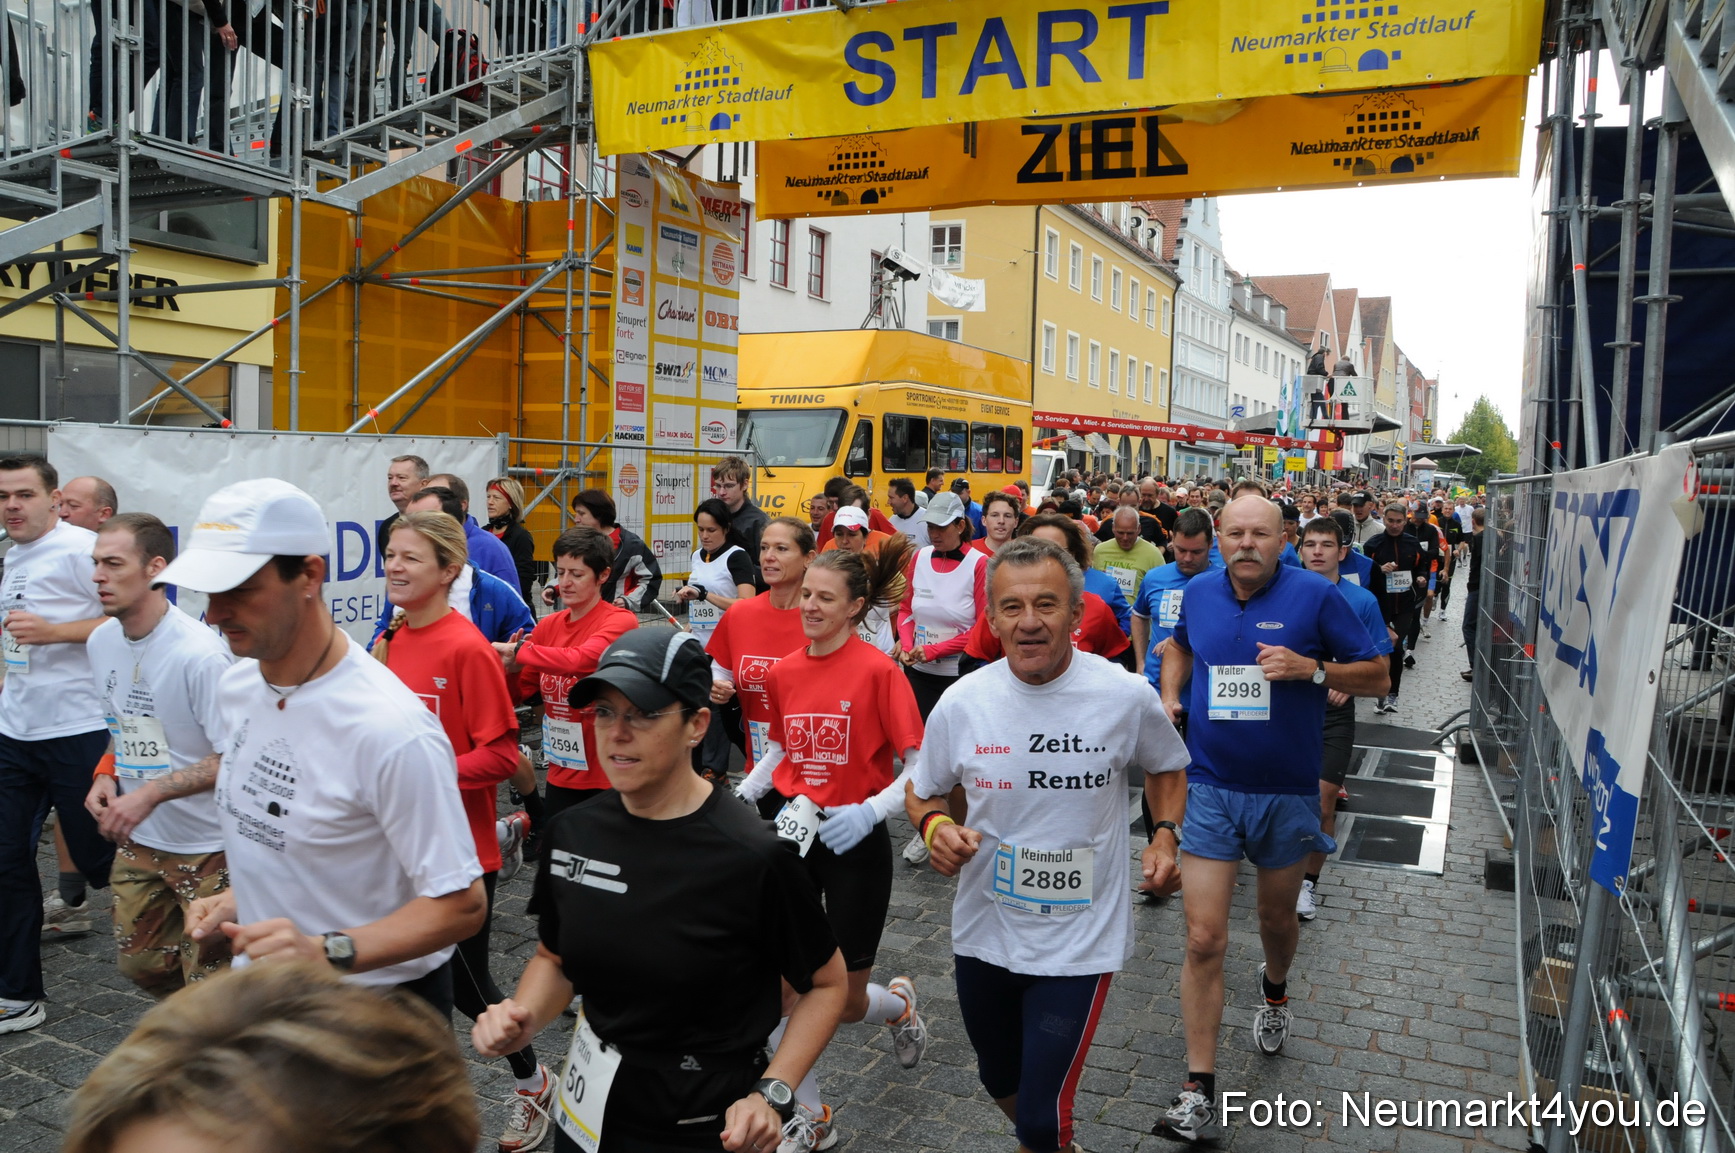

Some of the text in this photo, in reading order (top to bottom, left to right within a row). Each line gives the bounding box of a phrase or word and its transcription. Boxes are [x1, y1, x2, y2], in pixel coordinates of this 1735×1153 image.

[1230, 10, 1476, 54] Neumarkter Stadtlauf
[843, 0, 1170, 107] START
[626, 84, 795, 116] Neumarkter Stadtlauf
[1290, 126, 1480, 156] Neumarkter Stadtlauf
[1017, 116, 1188, 184] ZIEL
[785, 166, 930, 188] Neumarkter Stadtlauf
[700, 195, 741, 217] MERZ
[712, 259, 735, 272] WITTMANN
[617, 312, 646, 328] Sinupret
[705, 310, 739, 331] OBI
[617, 327, 635, 340] forte
[703, 365, 728, 382] MCM
[769, 394, 825, 405] TIMING
[906, 391, 937, 404] SPORTRONIC
[981, 403, 1010, 417] EVENT SERVICE
[1044, 415, 1069, 423] Service
[615, 432, 645, 441] HACKNER
[655, 473, 690, 491] Sinupret
[656, 491, 676, 504] forte
[755, 495, 786, 509] NIC
[693, 608, 714, 619] 2498
[858, 632, 872, 643] 96
[1217, 665, 1246, 676] Walter
[1217, 682, 1262, 698] 2998
[123, 740, 159, 758] 3123
[550, 736, 580, 755] 2594
[975, 732, 1106, 755] keine Zeit...
[791, 751, 804, 760] UN
[815, 751, 831, 760] NOT
[975, 768, 1111, 790] bin in Rente!
[777, 814, 809, 843] 593
[1021, 847, 1073, 863] Reinhold
[1021, 868, 1082, 890] 2886
[1051, 904, 1090, 912] PFLEIDERER
[566, 1063, 585, 1104] 50
